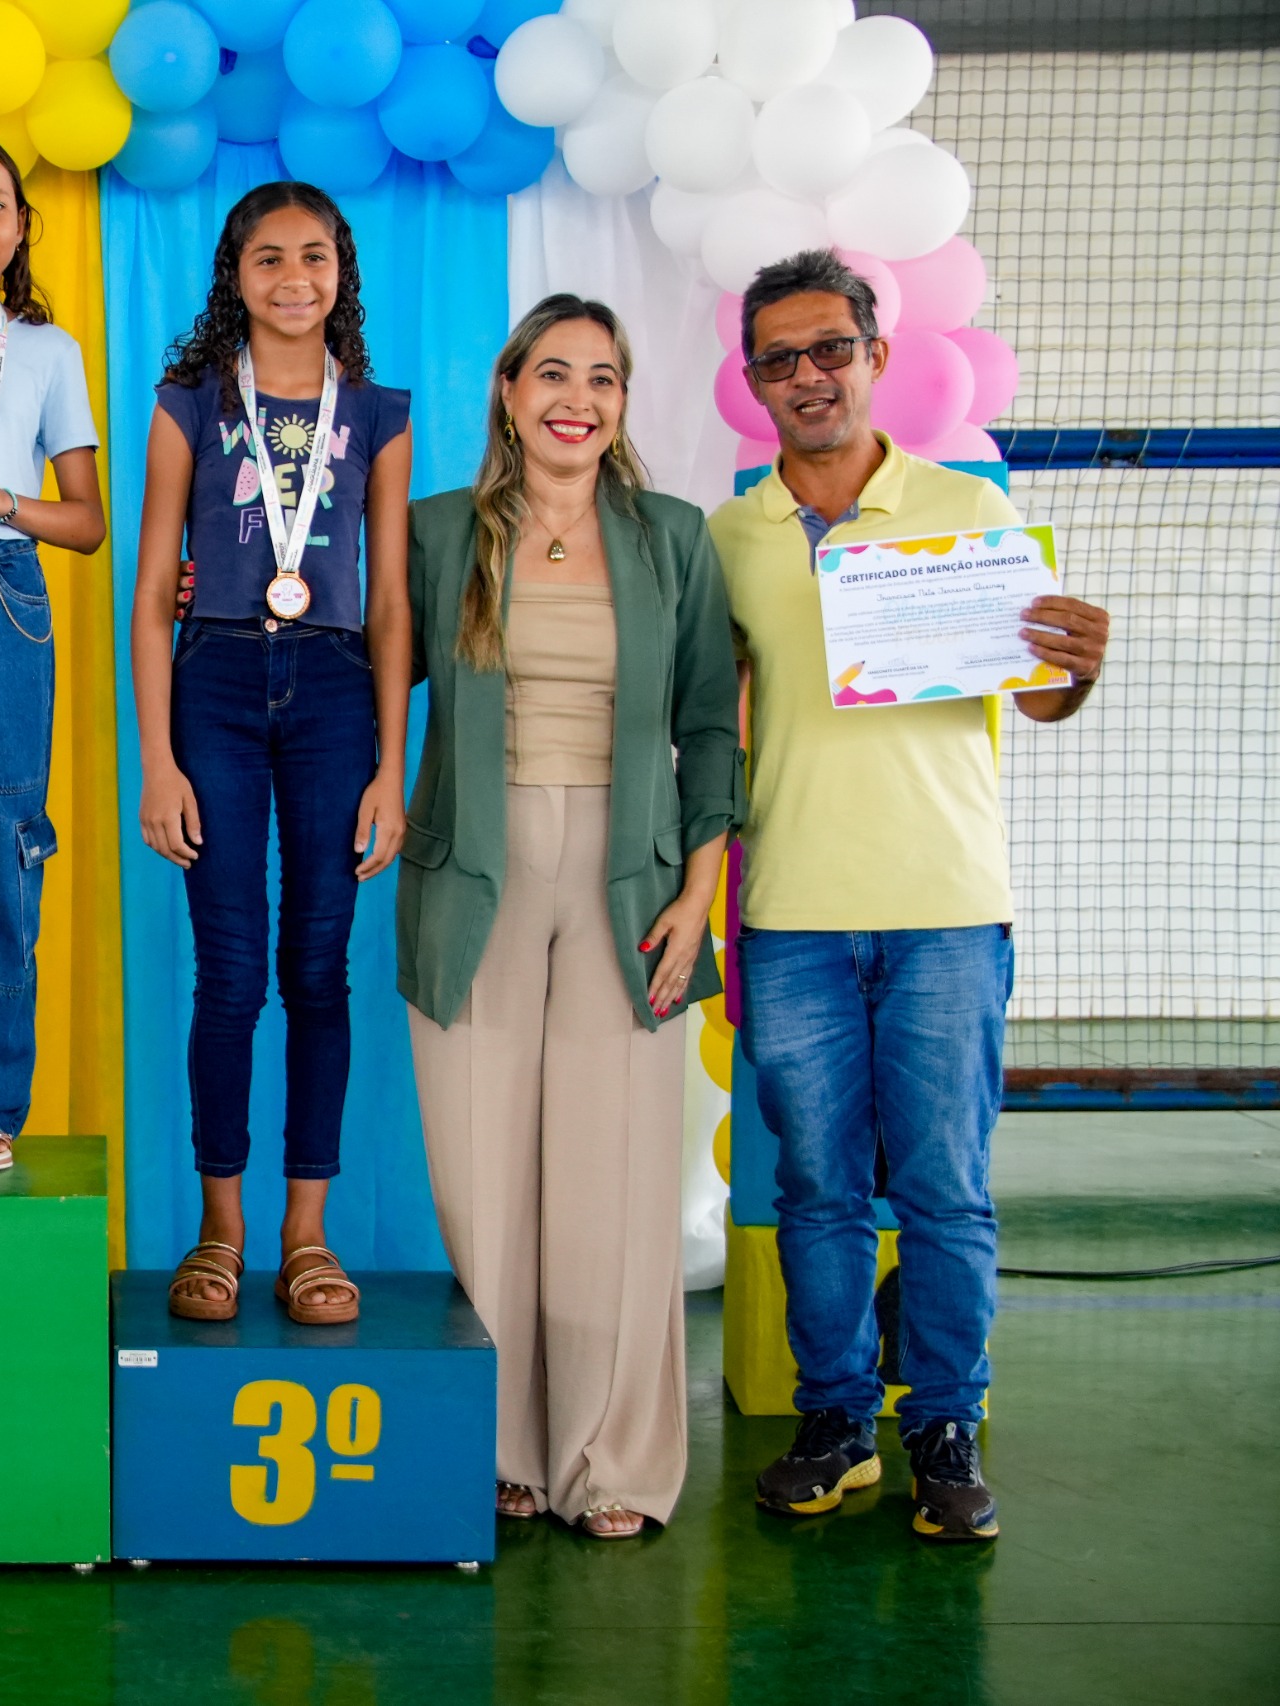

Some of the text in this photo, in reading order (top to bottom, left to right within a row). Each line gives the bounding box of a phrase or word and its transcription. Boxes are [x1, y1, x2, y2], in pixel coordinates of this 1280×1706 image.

[839, 567, 908, 585] CERTIFICADO
[910, 566, 924, 577] DE
[926, 558, 973, 575] MENÇÃO
[975, 554, 1030, 569] HONROSA
[230, 1380, 381, 1526] 3º
